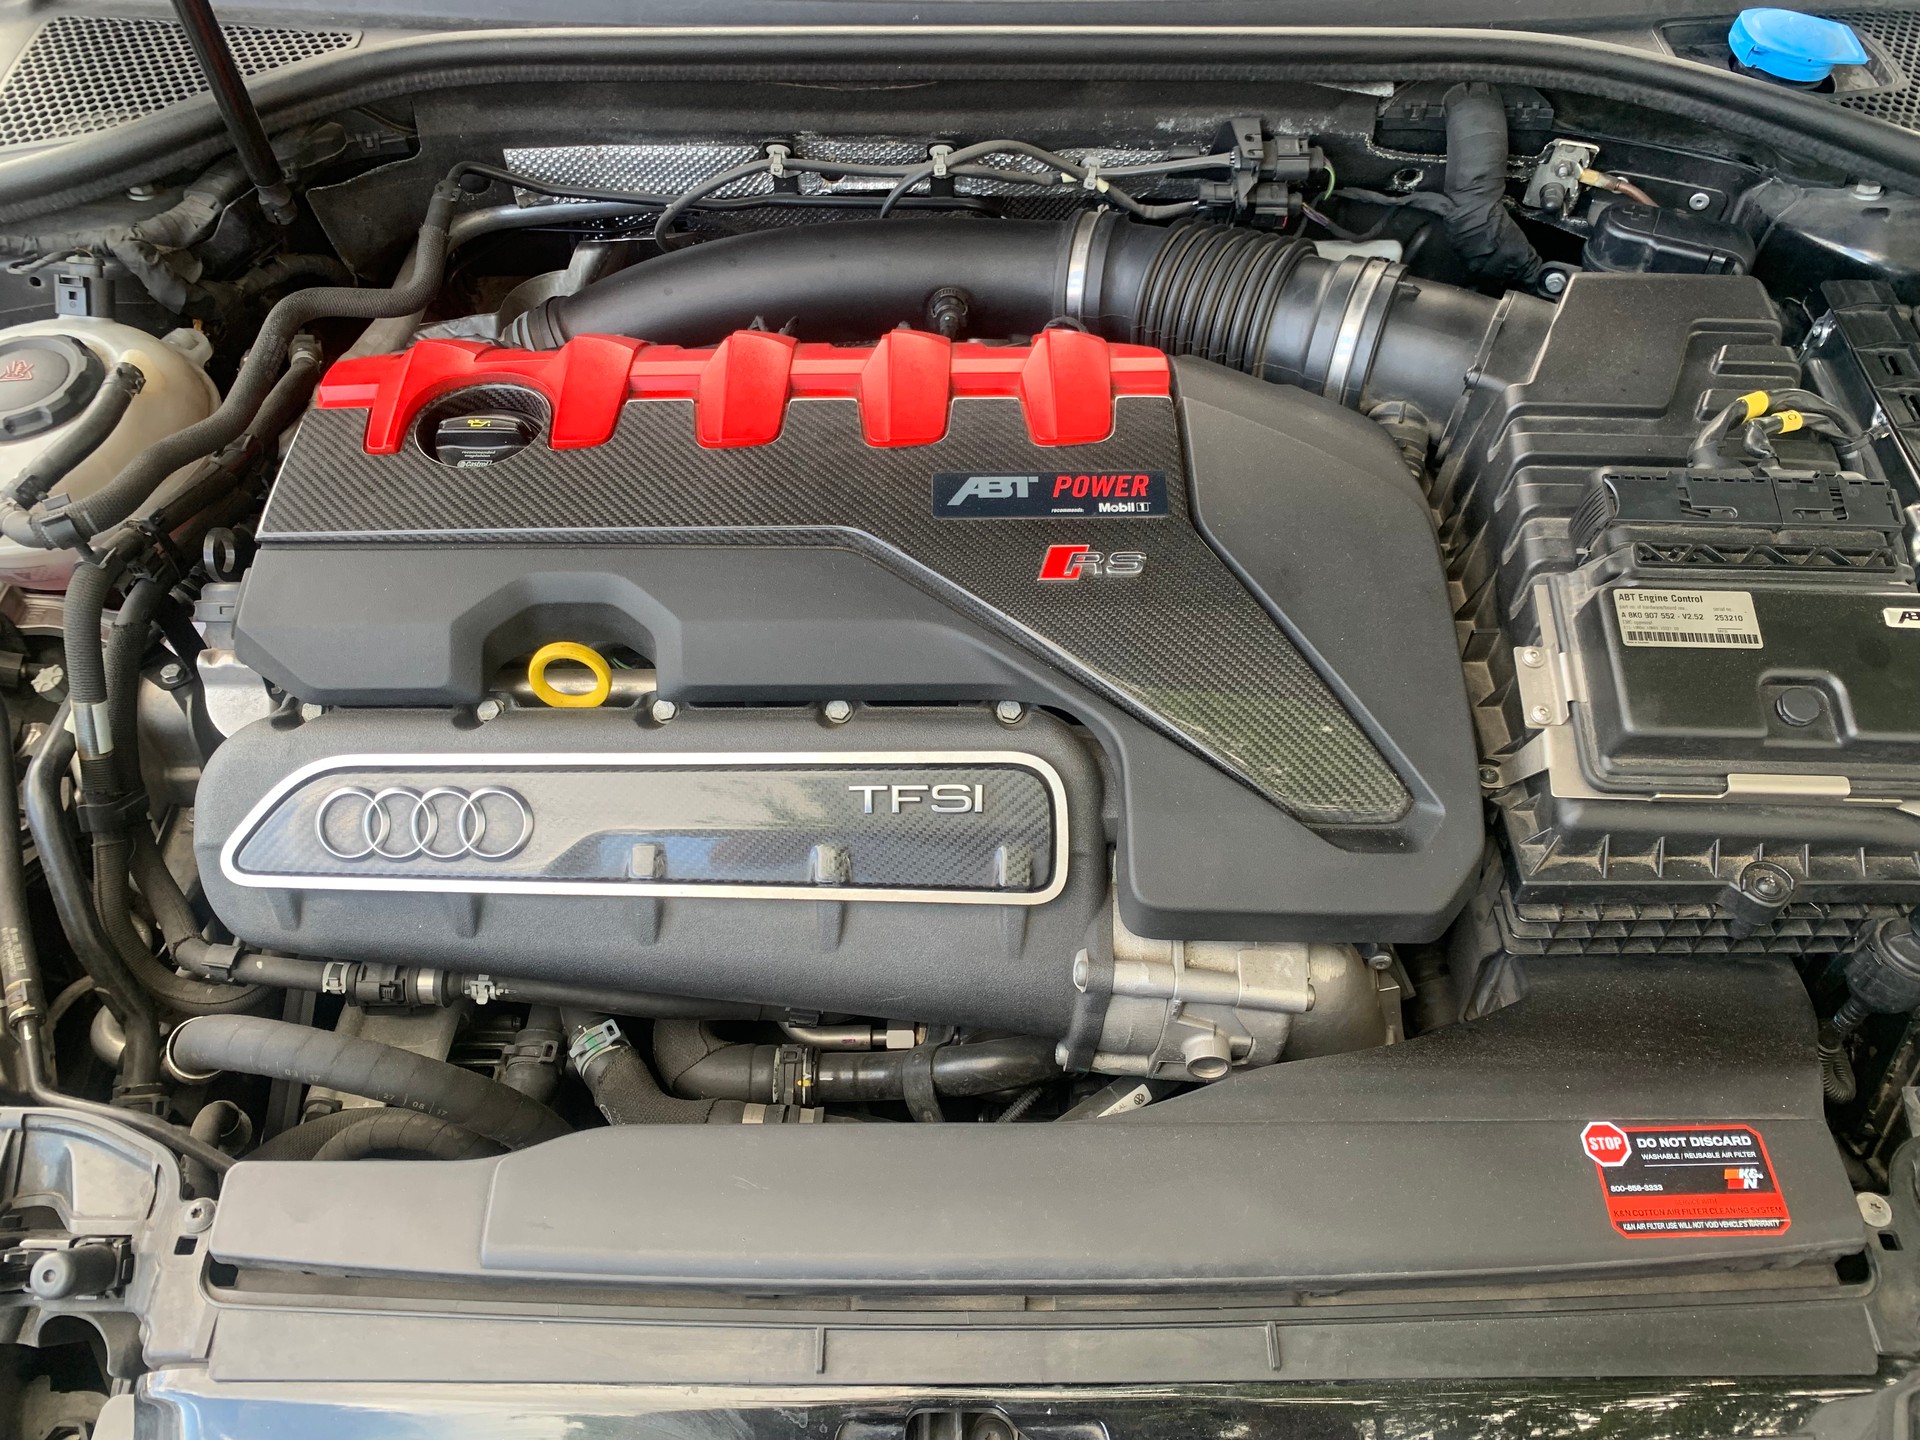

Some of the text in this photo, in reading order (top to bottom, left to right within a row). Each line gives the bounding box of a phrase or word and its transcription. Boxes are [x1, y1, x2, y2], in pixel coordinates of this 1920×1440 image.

[946, 474, 1149, 506] ABT POWER
[1098, 502, 1135, 513] Mobil
[1062, 549, 1148, 577] RS
[1618, 593, 1704, 603] ABT Engine Control
[1660, 612, 1675, 620] 552
[1714, 614, 1744, 622] 253210
[848, 784, 983, 814] TFSI
[1588, 1136, 1622, 1151] STOP
[1636, 1135, 1752, 1149] DO NOT DISCARD
[1641, 1152, 1681, 1160] WASHABLE
[1684, 1151, 1721, 1160] REUSABLE
[1721, 1151, 1734, 1159] AIR
[1613, 1206, 1782, 1217] K&N COTTON AIR FILTER CLEANING SYSTEM
[1622, 1223, 1636, 1231] K&N
[1637, 1222, 1646, 1230] AIR
[1646, 1222, 1666, 1230] FILTER
[1665, 1222, 1678, 1230] USE
[1677, 1221, 1692, 1229] WILL
[1692, 1221, 1705, 1229] NOT
[1705, 1220, 1719, 1229] VOID
